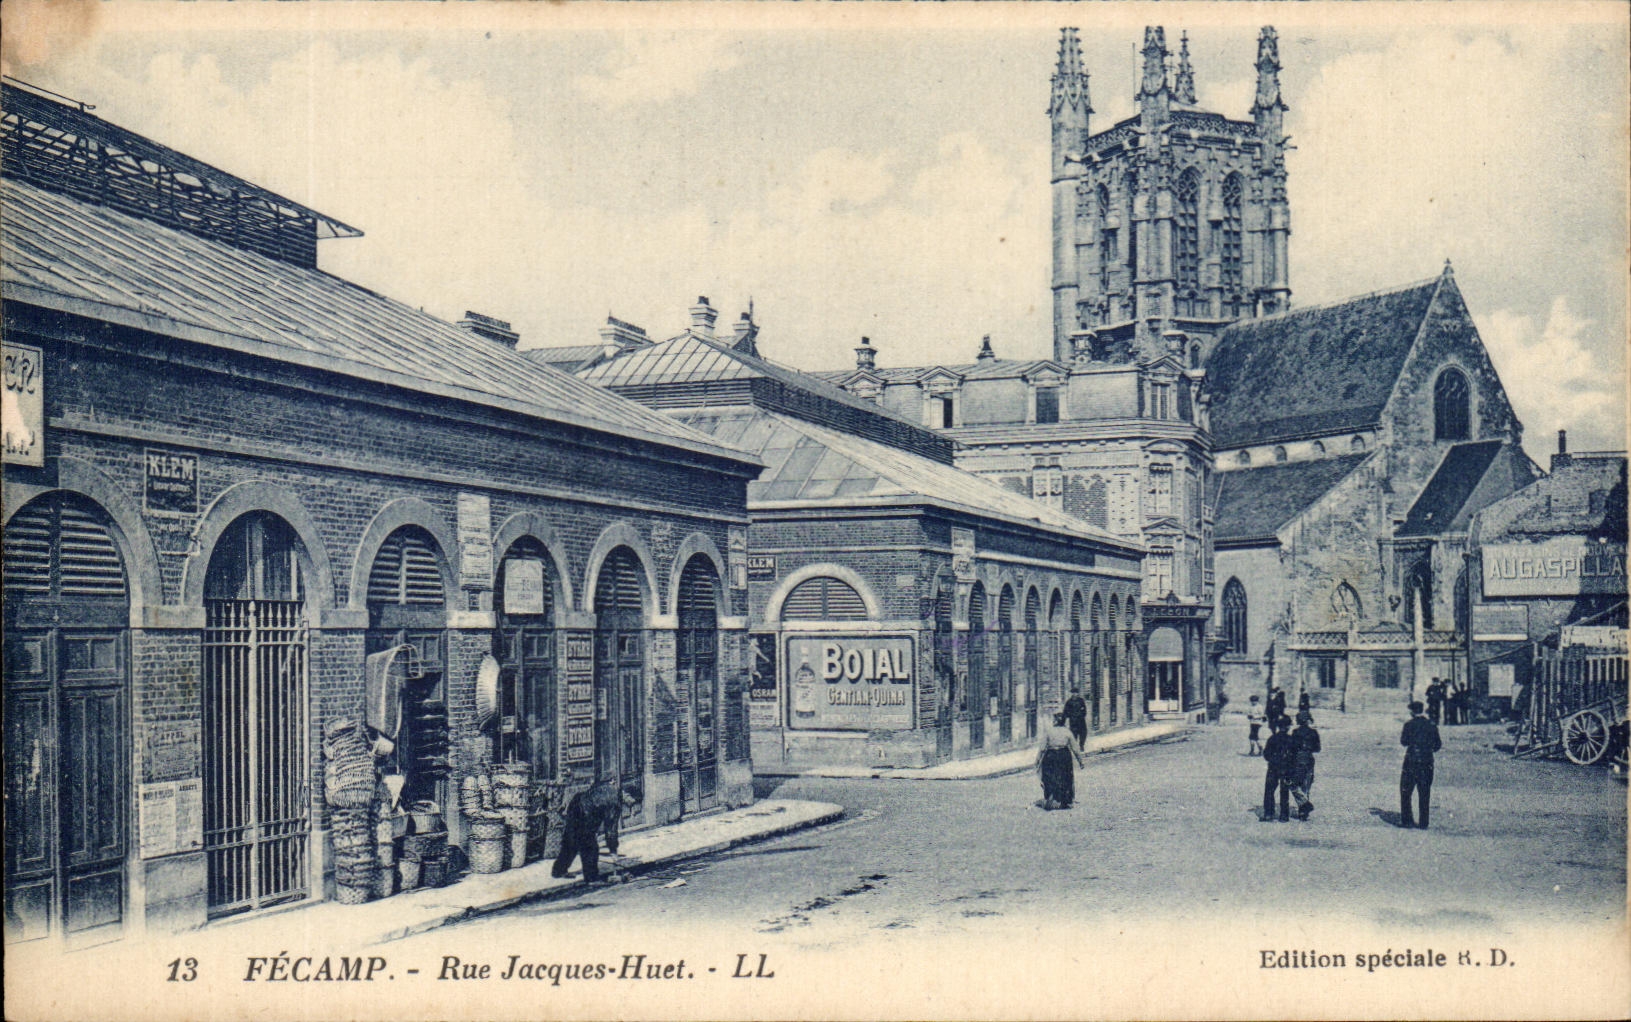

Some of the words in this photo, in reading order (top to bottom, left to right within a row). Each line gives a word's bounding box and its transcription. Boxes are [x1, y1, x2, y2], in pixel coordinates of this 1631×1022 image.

[148, 454, 195, 480] KLEM
[822, 642, 911, 684] BOIAL
[751, 688, 777, 698] OSRAM
